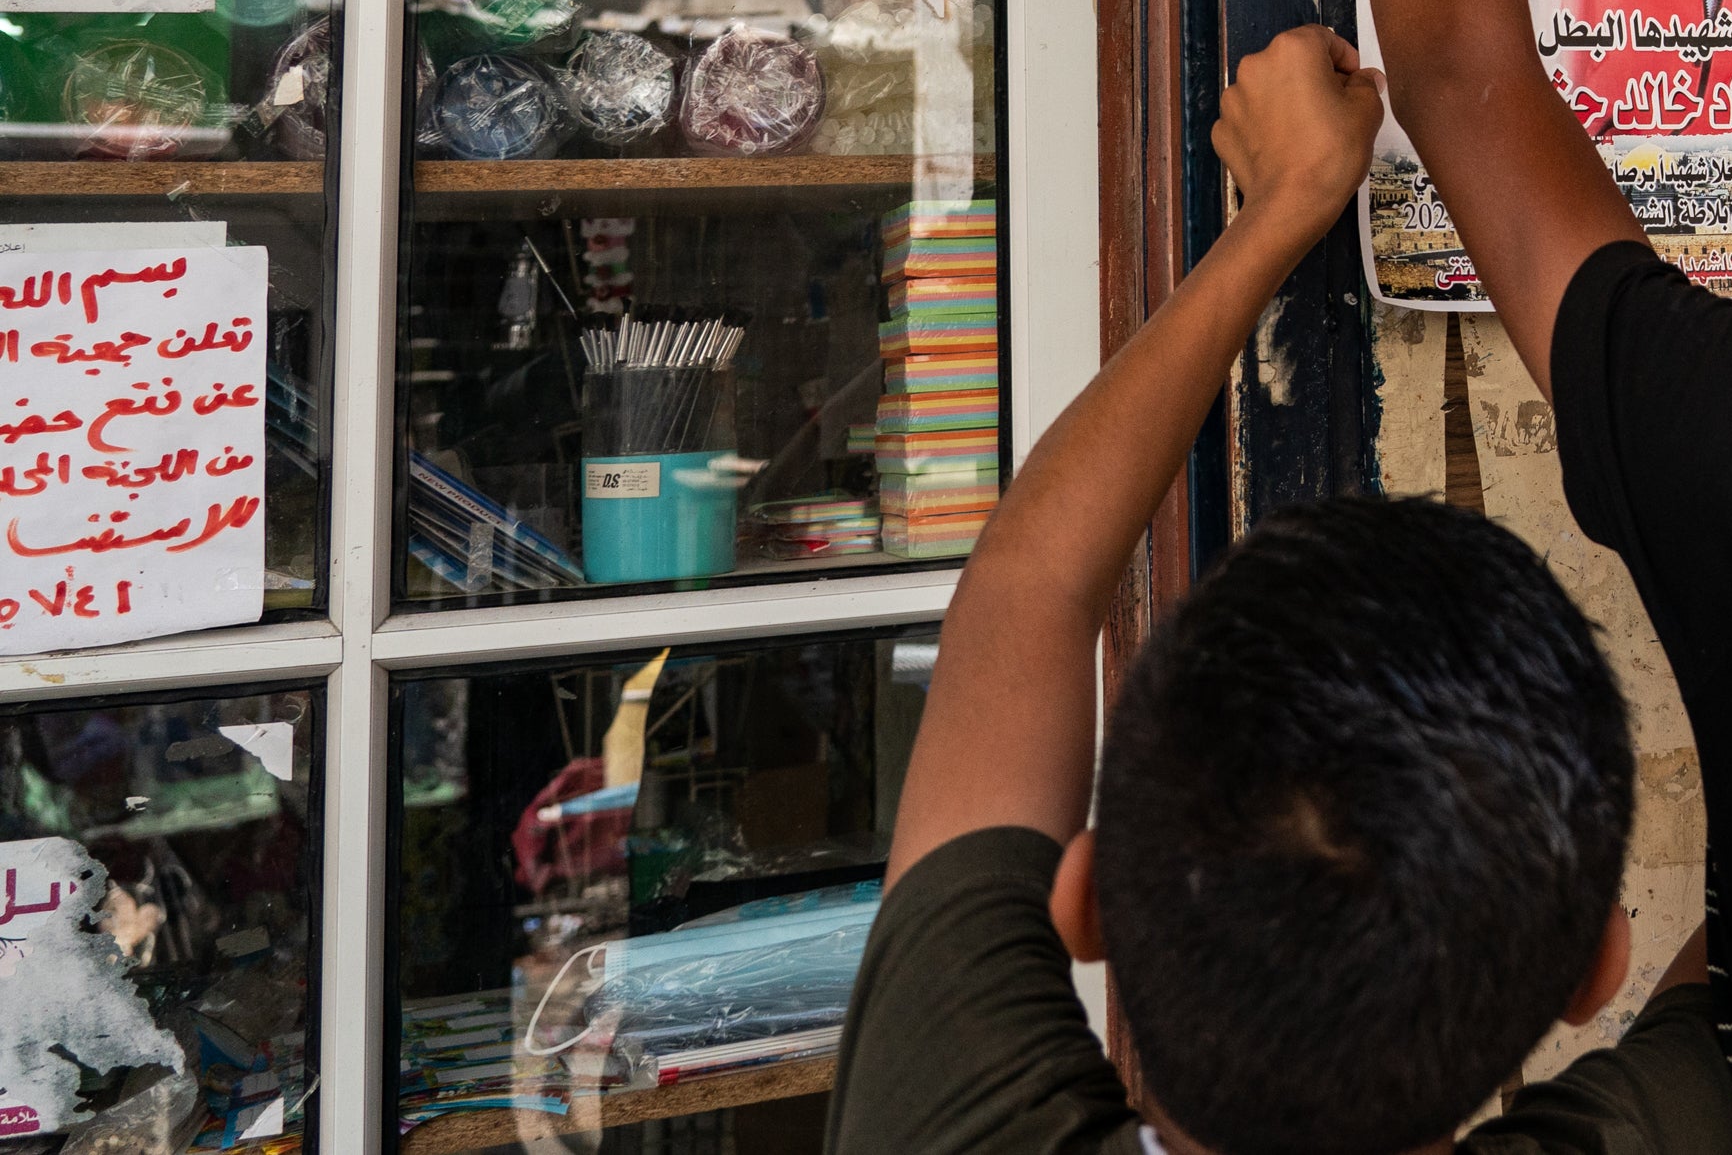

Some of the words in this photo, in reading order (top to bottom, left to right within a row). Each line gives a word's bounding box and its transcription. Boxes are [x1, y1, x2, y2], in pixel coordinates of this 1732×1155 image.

[1539, 10, 1625, 59] البطل
[1614, 72, 1703, 128] خالد
[1404, 203, 1455, 229] 202
[1680, 199, 1730, 232] بلاطة
[81, 257, 187, 323] بسم
[31, 331, 152, 376] جمعية
[157, 318, 254, 359] تعلن
[193, 383, 260, 416] عن
[82, 448, 199, 501] اللجنة
[205, 446, 254, 477] من
[418, 472, 447, 490] NEW
[447, 489, 503, 526] PRODUCT
